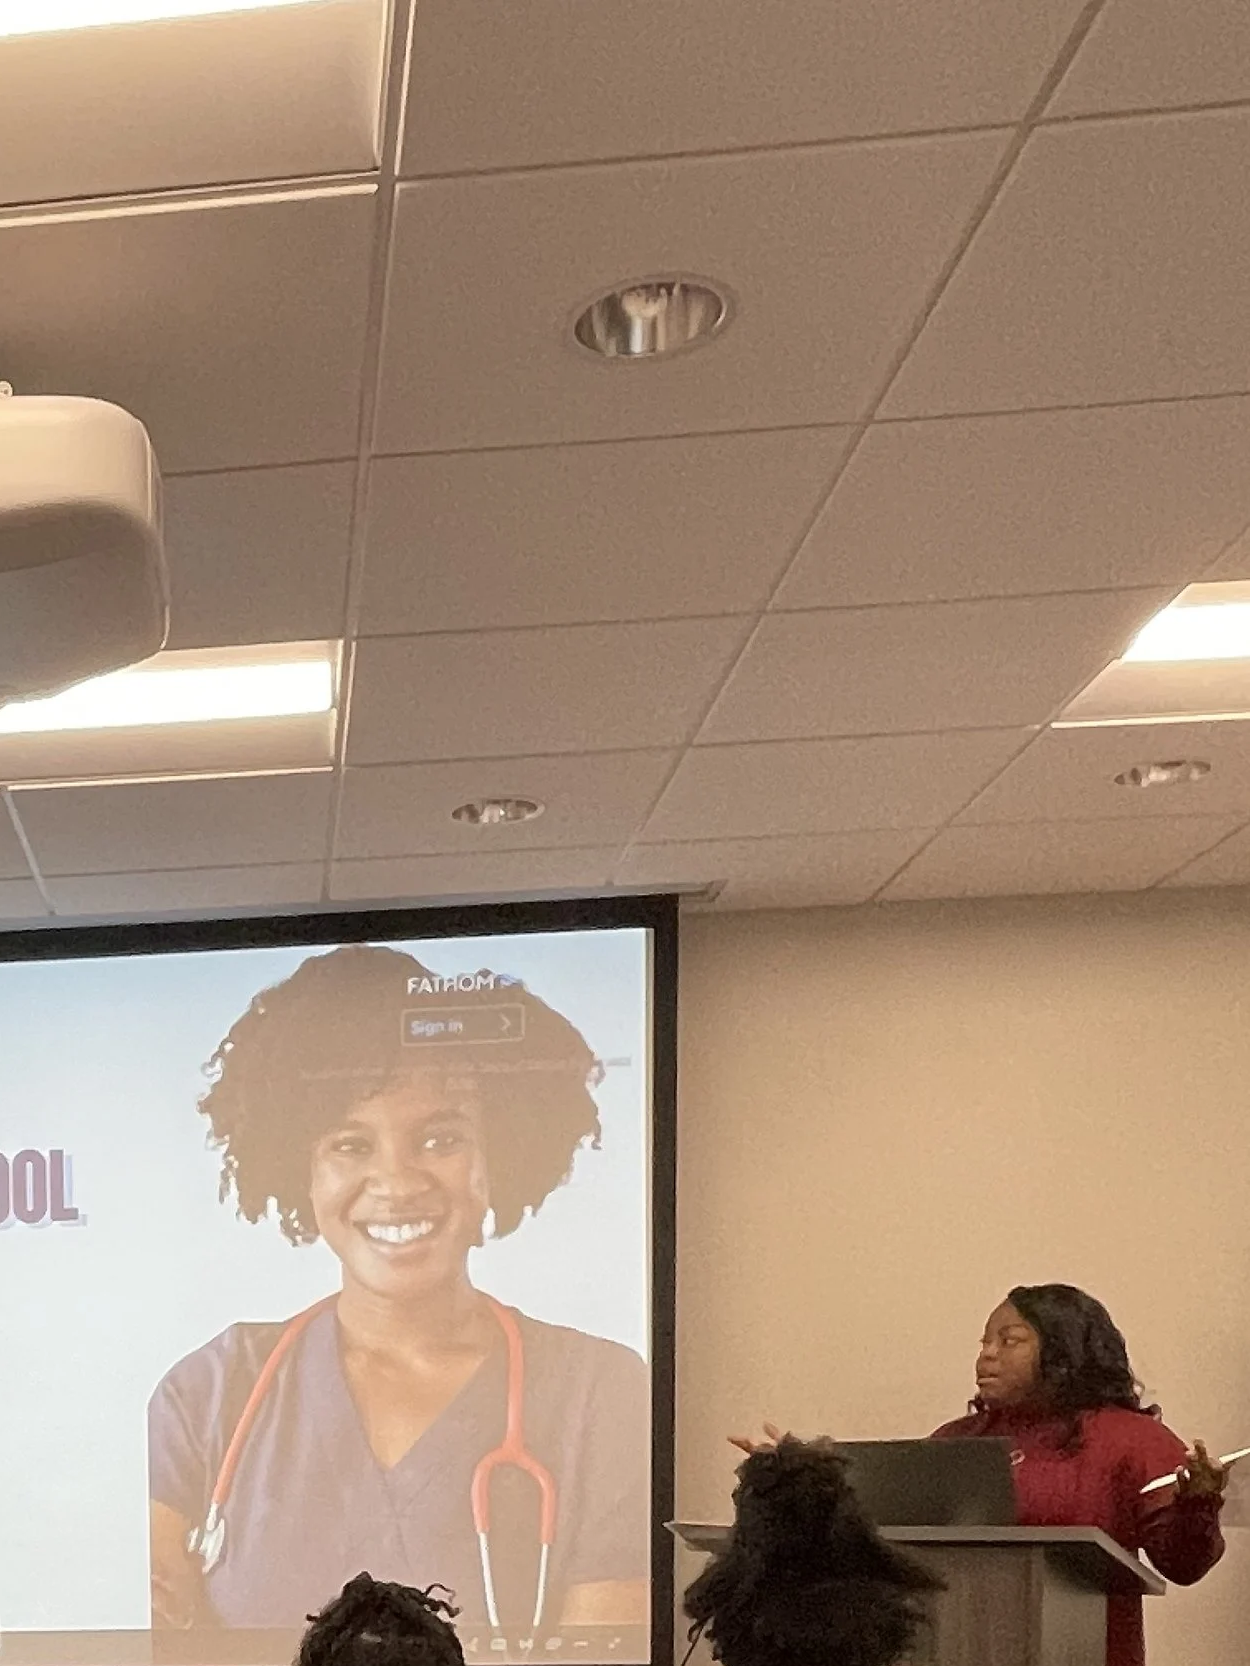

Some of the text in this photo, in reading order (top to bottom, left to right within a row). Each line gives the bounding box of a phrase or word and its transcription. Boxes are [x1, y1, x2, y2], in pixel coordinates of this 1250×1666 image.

[406, 973, 495, 995] FATHOM
[410, 1018, 464, 1037] Sign in
